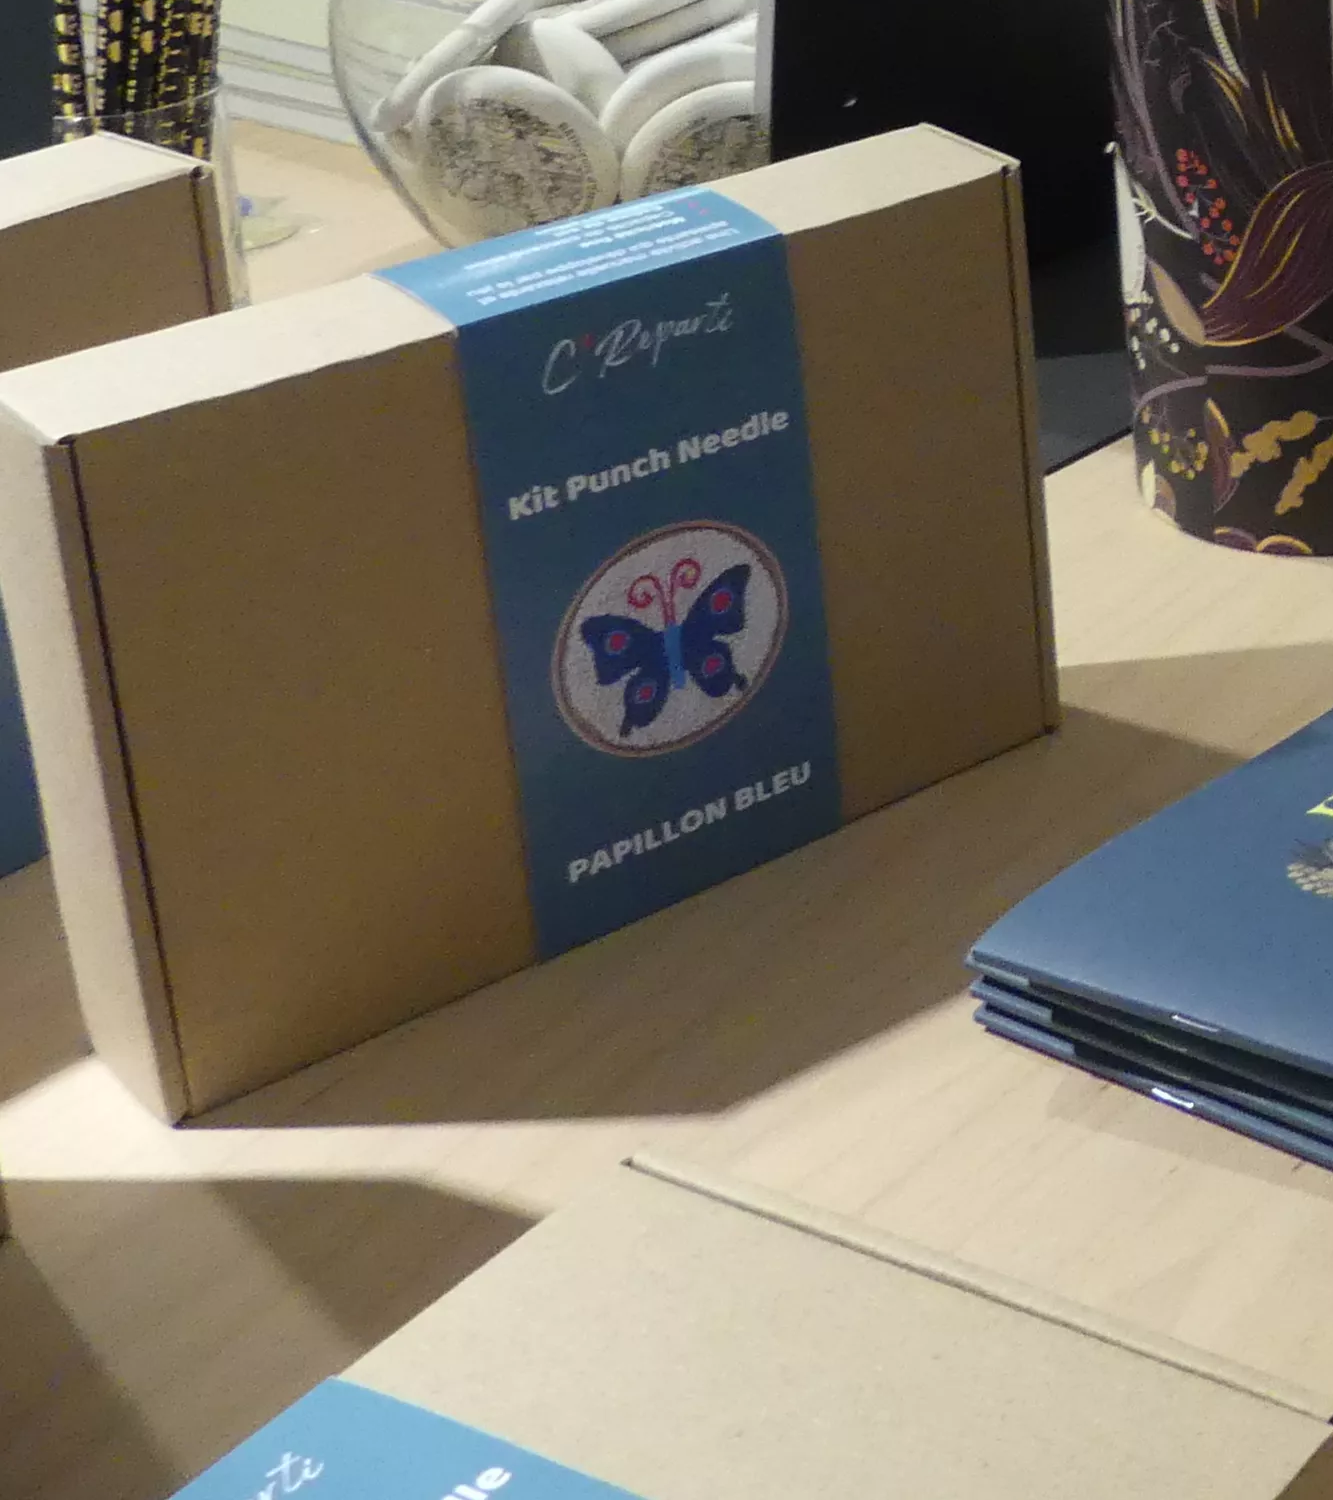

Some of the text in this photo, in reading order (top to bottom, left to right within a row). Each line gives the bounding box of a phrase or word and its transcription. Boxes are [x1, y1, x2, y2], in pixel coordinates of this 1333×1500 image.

[508, 409, 790, 520] Kit Punch Needle
[567, 760, 812, 883] PAPILLON BLEU
